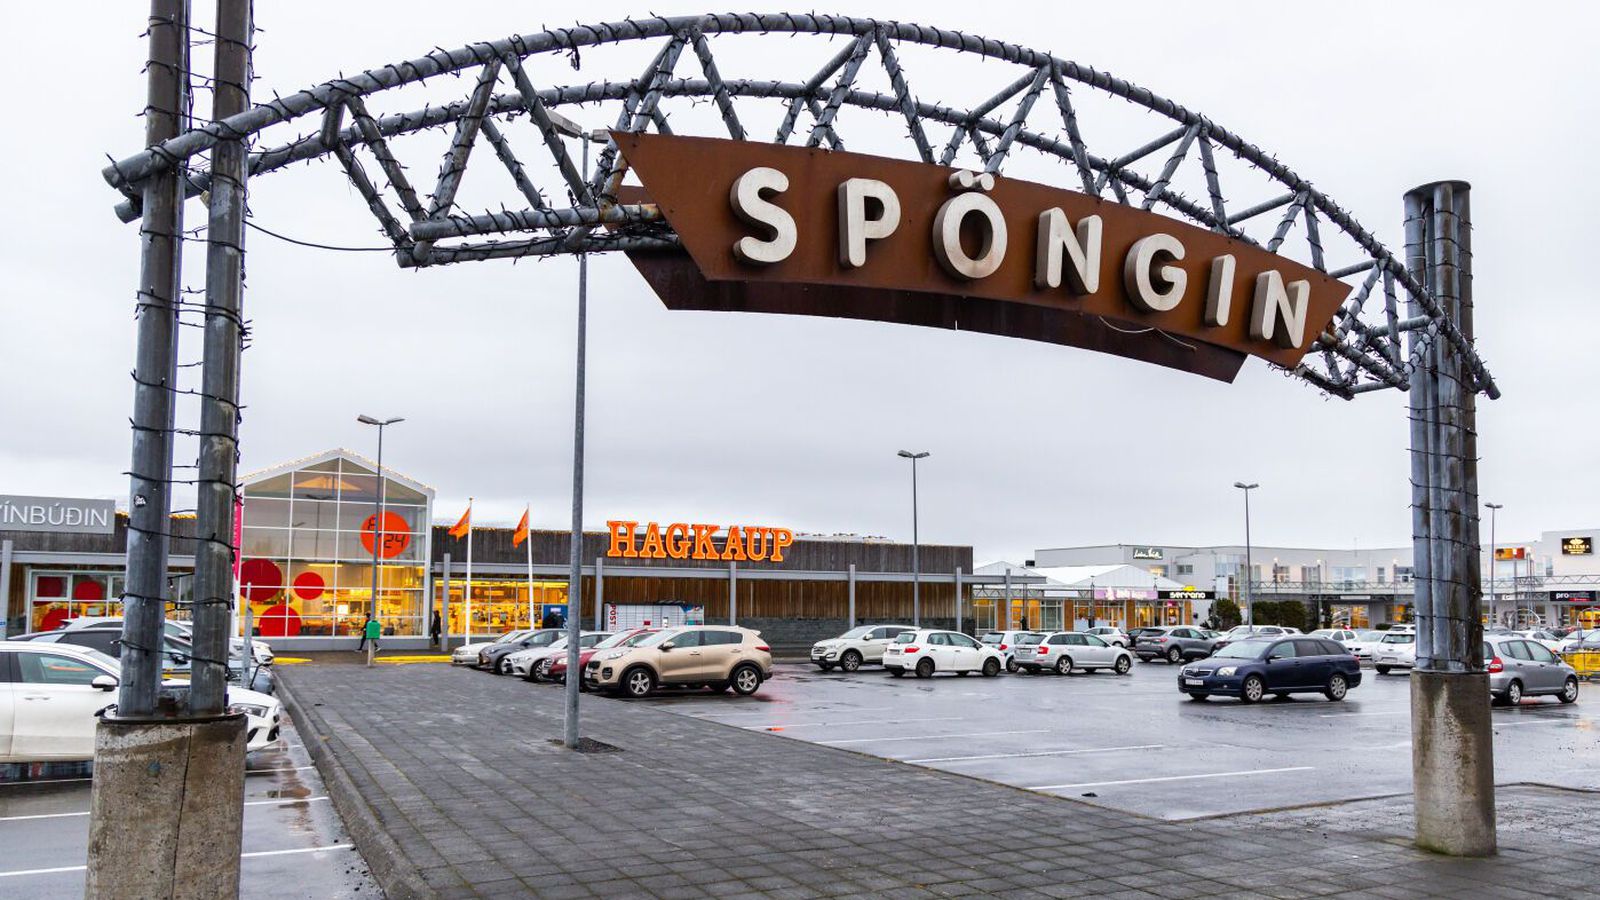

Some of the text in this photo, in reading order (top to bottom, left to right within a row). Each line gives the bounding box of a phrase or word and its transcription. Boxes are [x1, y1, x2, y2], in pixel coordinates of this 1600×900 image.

[730, 167, 1310, 350] SPÖNGIN
[0, 500, 108, 527] ÍNBÚÐIN
[606, 520, 793, 562] HAGKAUP
[1169, 591, 1206, 599] serrano
